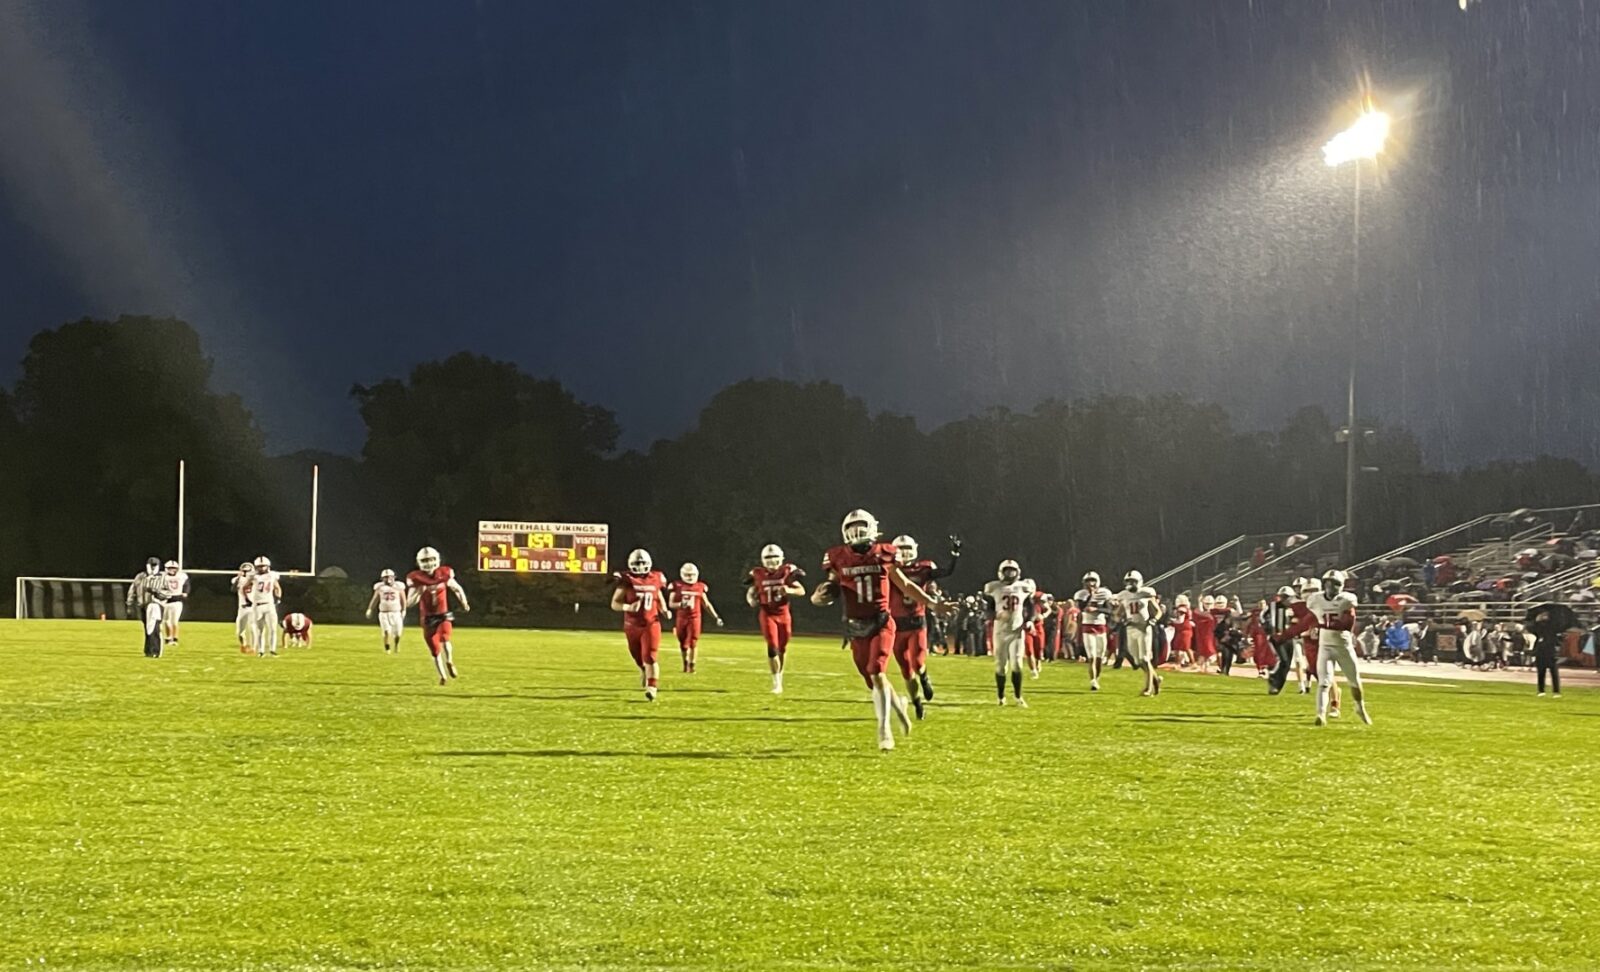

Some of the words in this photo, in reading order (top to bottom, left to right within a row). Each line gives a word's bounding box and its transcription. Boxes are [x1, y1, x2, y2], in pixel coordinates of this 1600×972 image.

[493, 523, 551, 531] WHITEHALL
[498, 544, 507, 557] 7
[587, 546, 596, 559] 0
[489, 560, 511, 568] DOWN
[529, 560, 539, 569] TO
[541, 561, 552, 569] GO
[583, 562, 597, 570] QTR
[854, 575, 873, 603] 11
